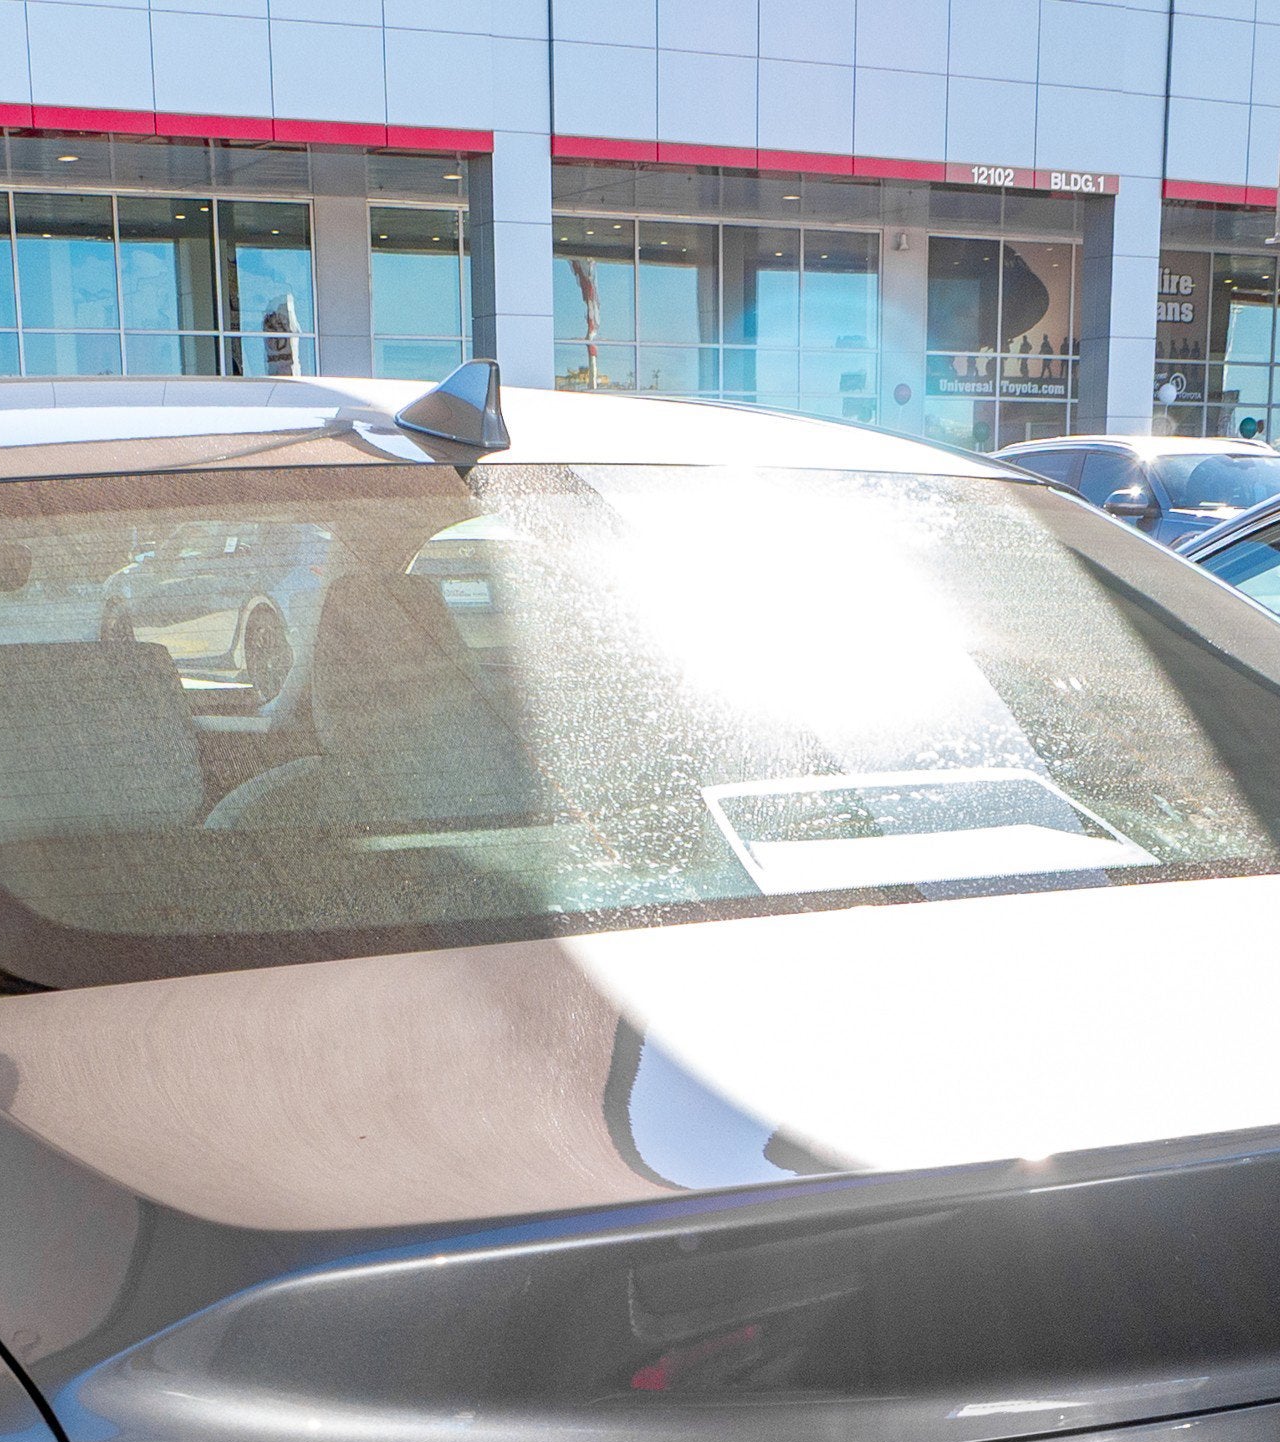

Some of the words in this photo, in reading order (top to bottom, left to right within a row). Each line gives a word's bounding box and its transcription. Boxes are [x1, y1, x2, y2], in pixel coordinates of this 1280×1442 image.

[972, 166, 1015, 187] 12102
[939, 379, 993, 393] Universal
[1001, 380, 1065, 396] Toyota.com
